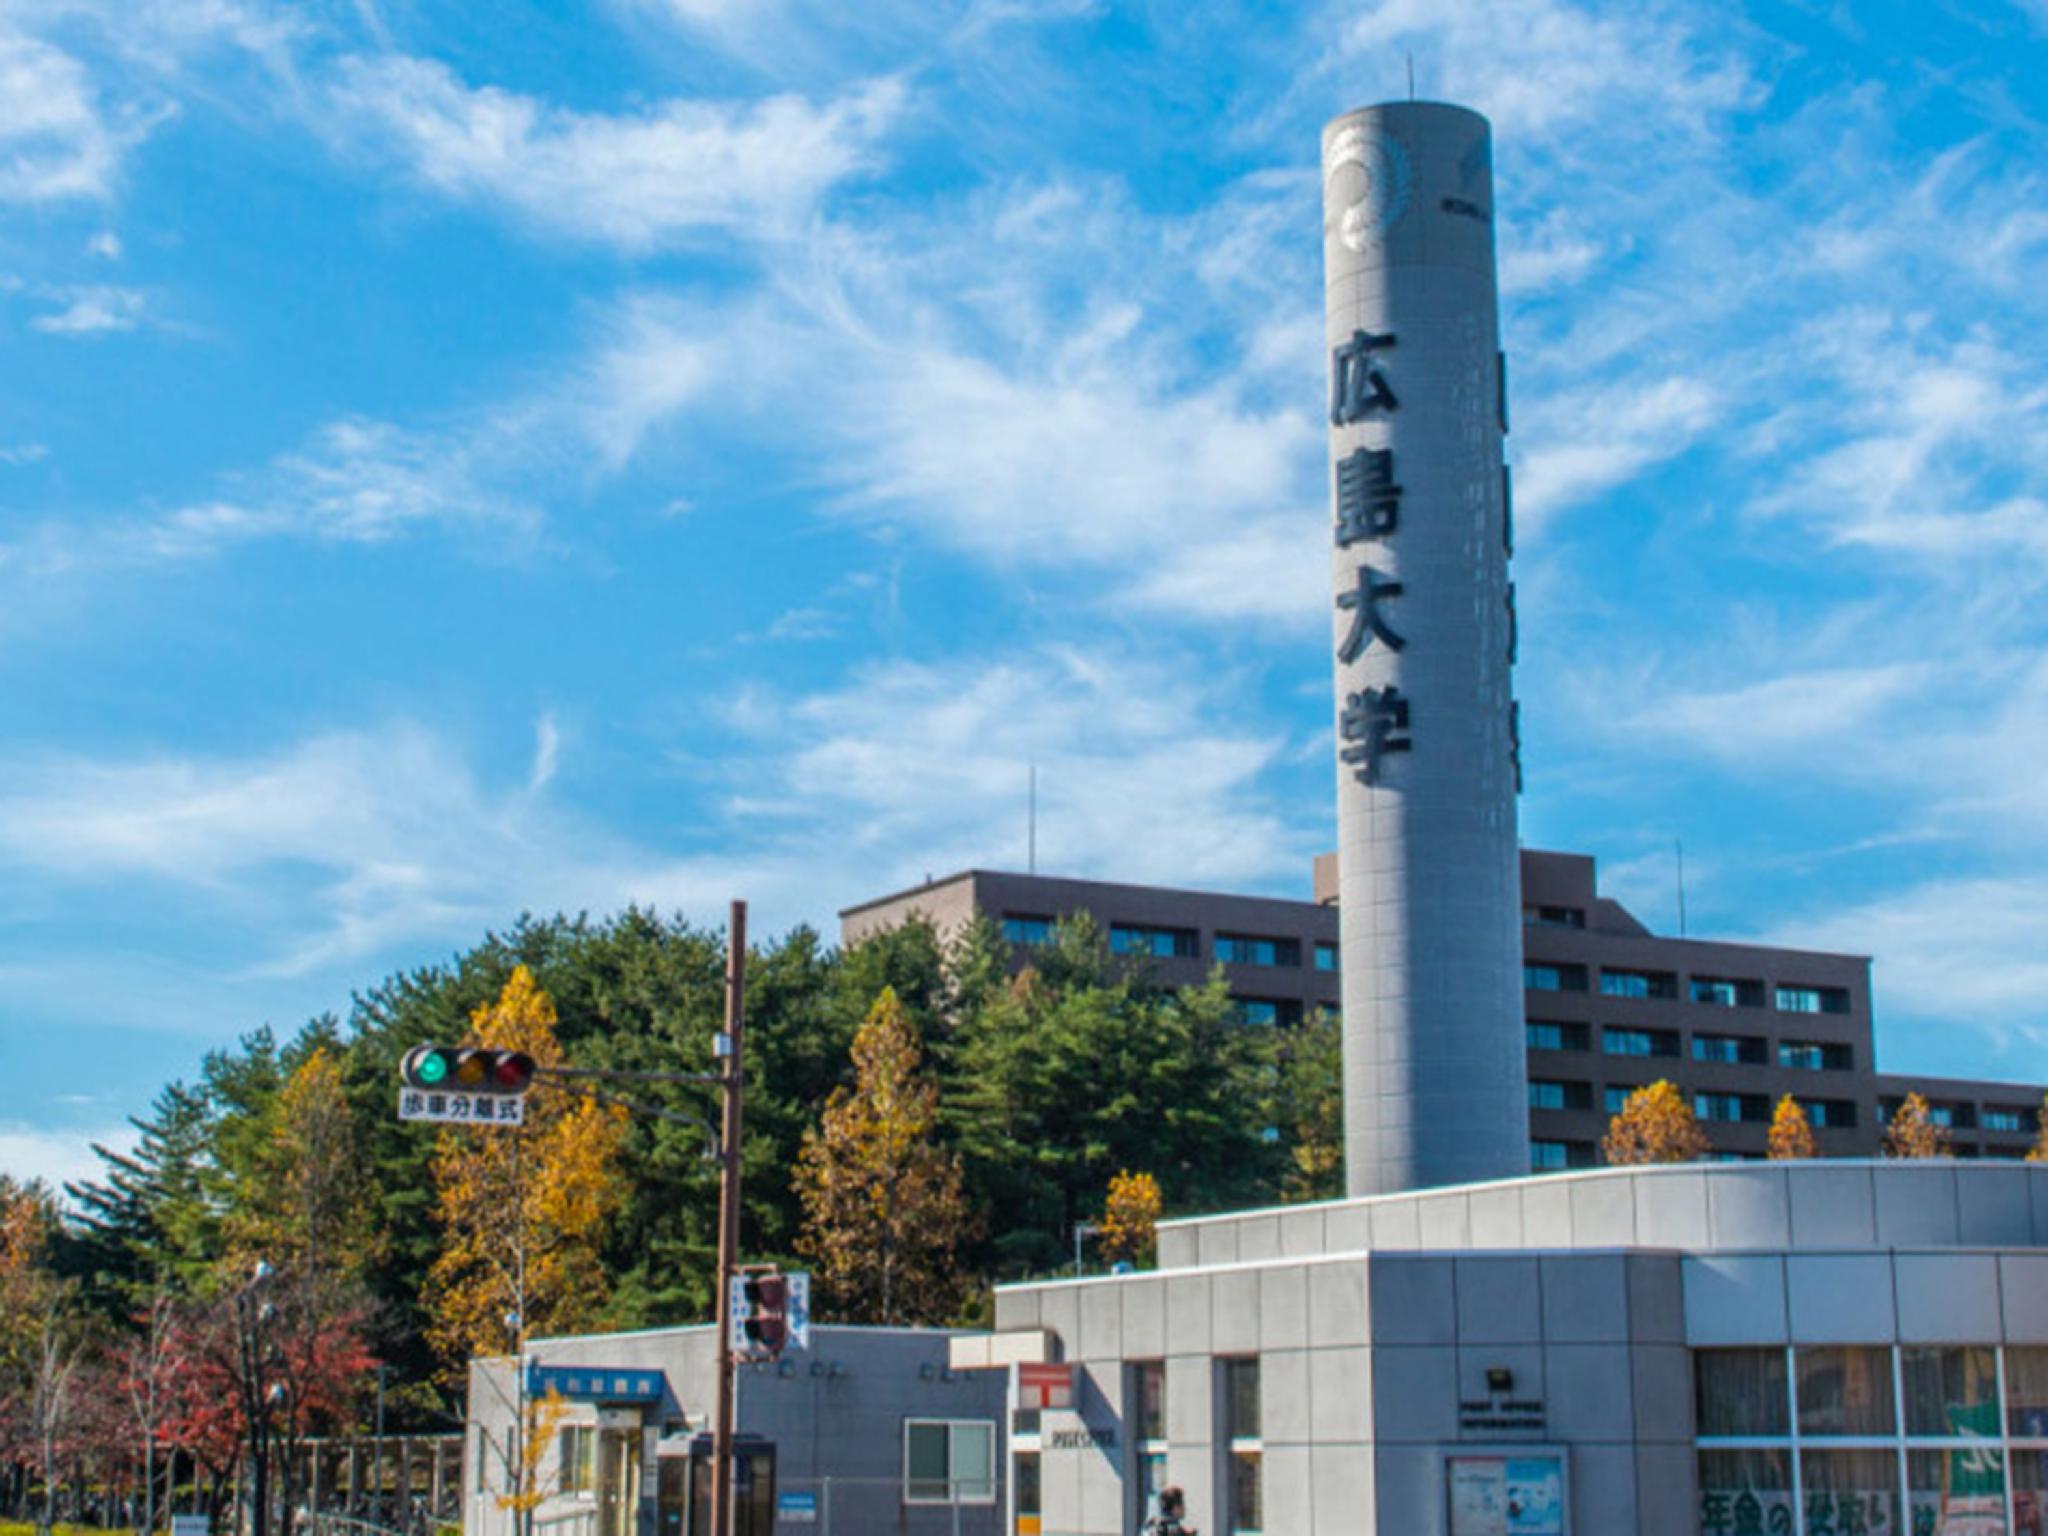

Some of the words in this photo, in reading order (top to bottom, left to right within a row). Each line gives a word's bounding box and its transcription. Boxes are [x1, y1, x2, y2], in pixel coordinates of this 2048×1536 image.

[1331, 329, 1412, 787] 広島大学
[404, 1093, 518, 1120] 歩車分離式
